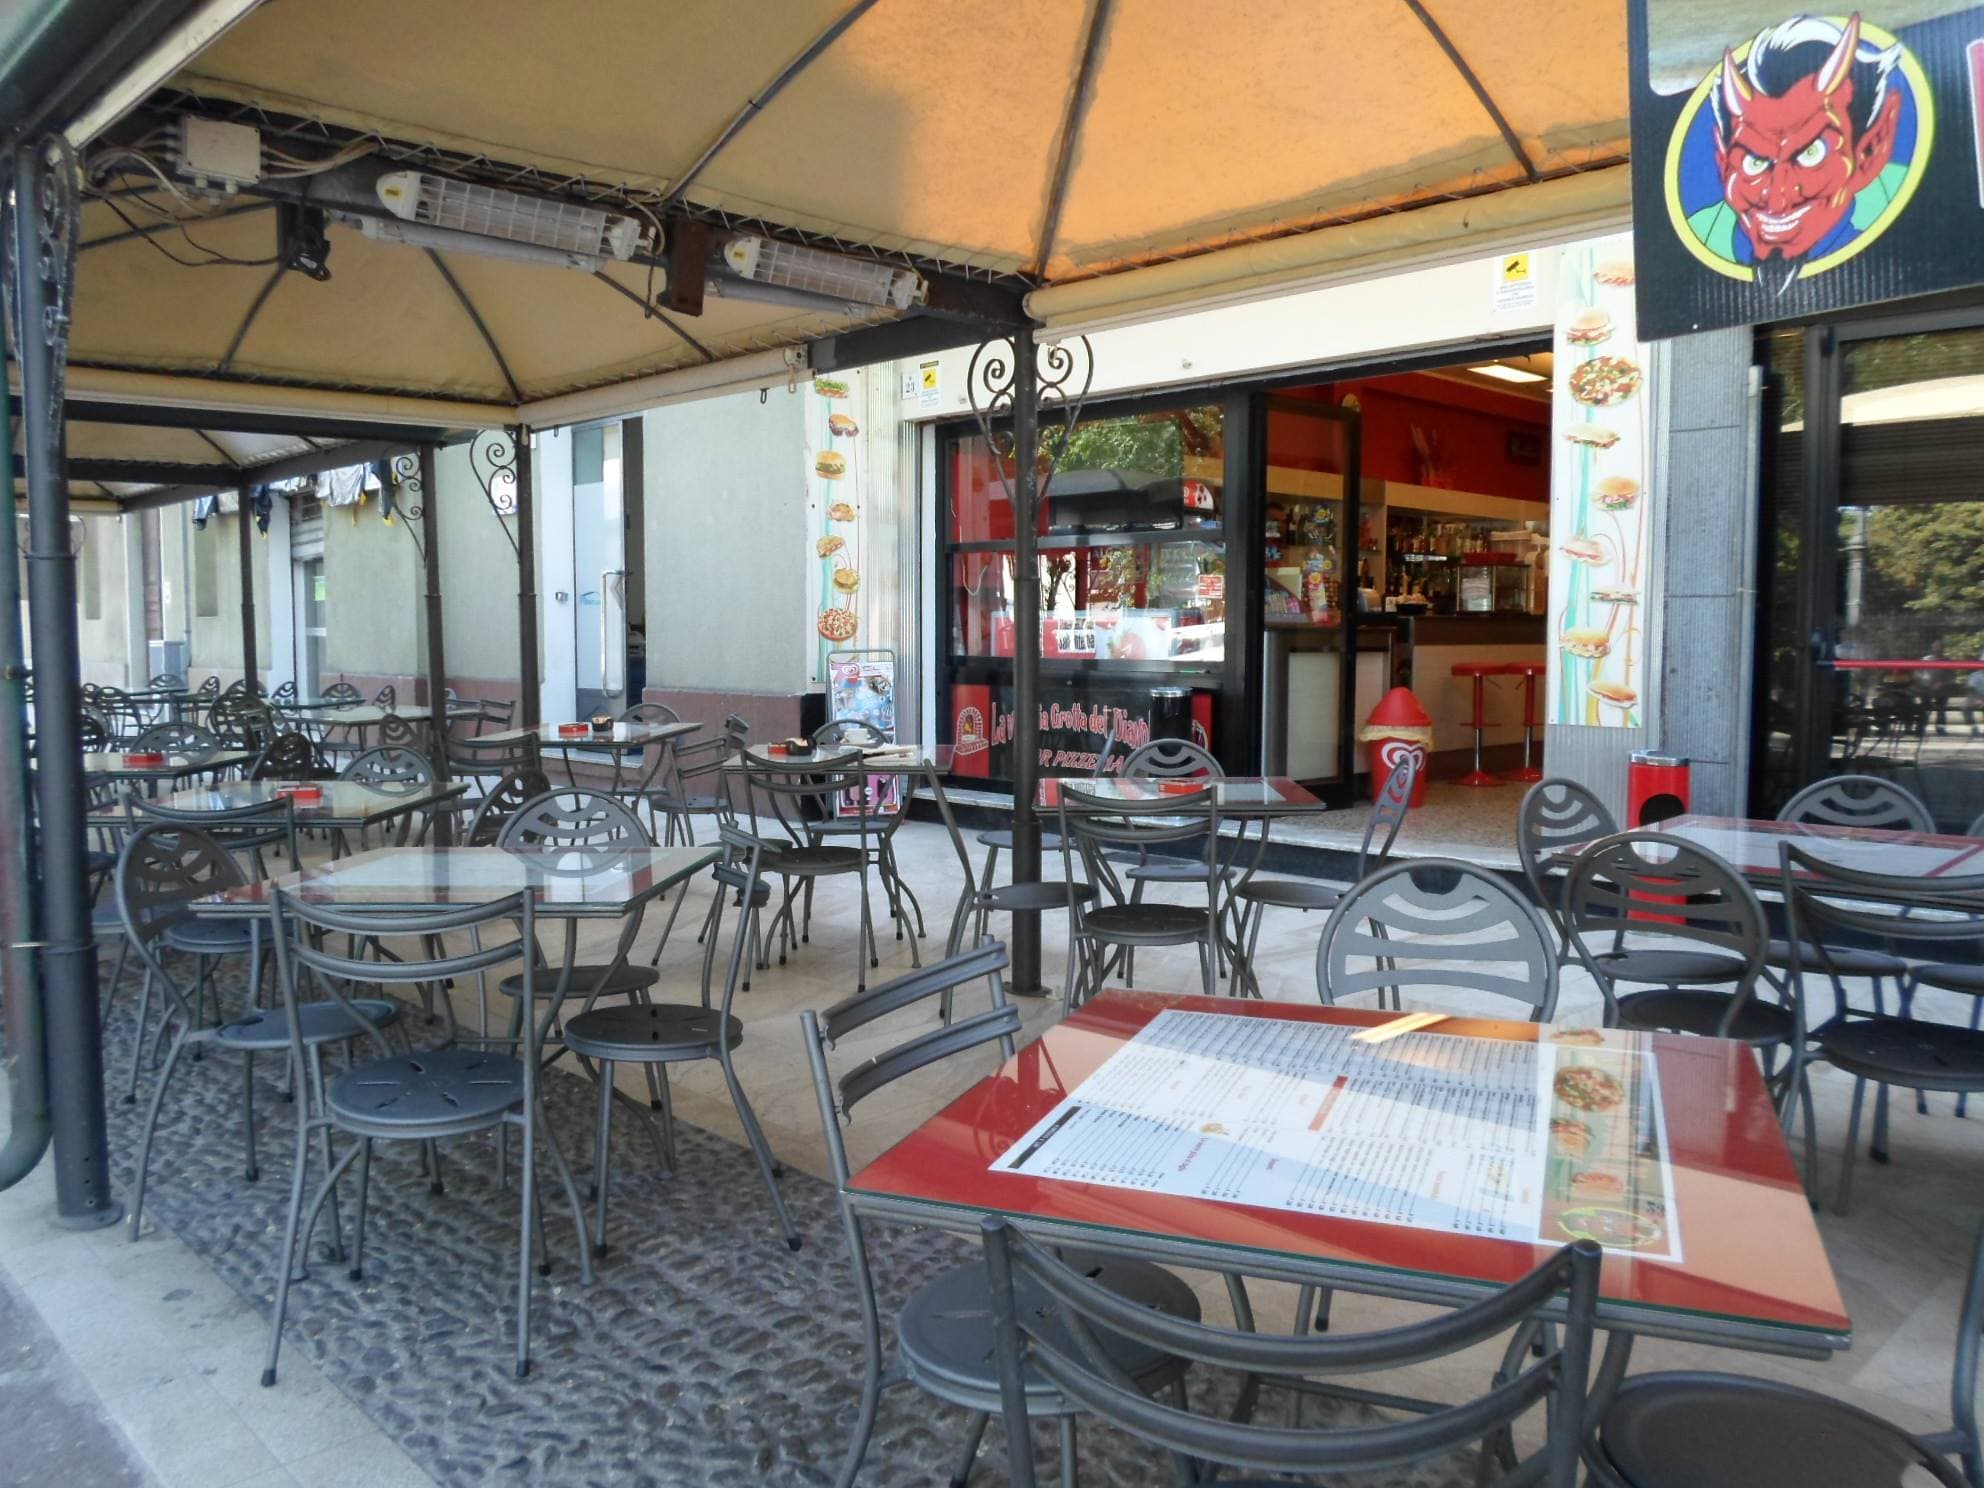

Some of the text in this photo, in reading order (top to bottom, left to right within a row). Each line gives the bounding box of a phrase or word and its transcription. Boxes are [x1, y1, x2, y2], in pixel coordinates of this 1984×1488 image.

[991, 702, 1006, 746] La
[1051, 703, 1087, 732] Grotta
[1089, 704, 1108, 738] del
[1113, 707, 1151, 749] Diavo
[1052, 750, 1124, 773] PIZZEIA
